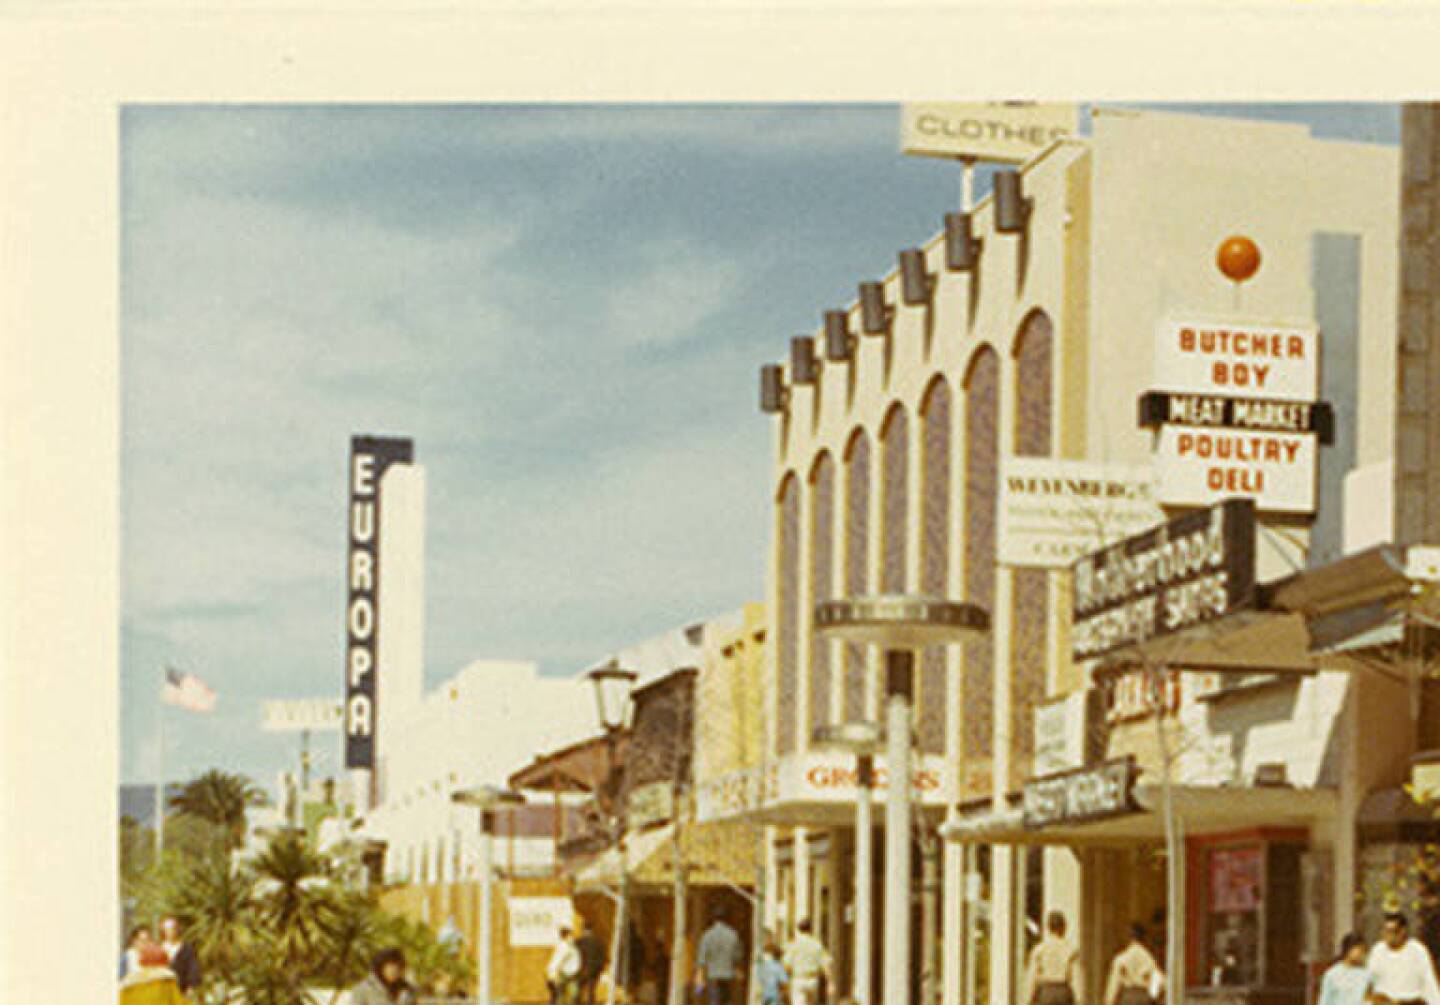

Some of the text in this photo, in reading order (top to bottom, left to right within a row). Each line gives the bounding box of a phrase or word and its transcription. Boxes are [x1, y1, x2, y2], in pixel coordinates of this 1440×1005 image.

[1178, 327, 1305, 361] BUTCHER
[1211, 360, 1270, 390] BOY
[1170, 396, 1311, 432] MEAT MARKET
[1177, 433, 1302, 465] POULTRY
[1207, 466, 1265, 493] DELI
[350, 454, 376, 737] EUROPA
